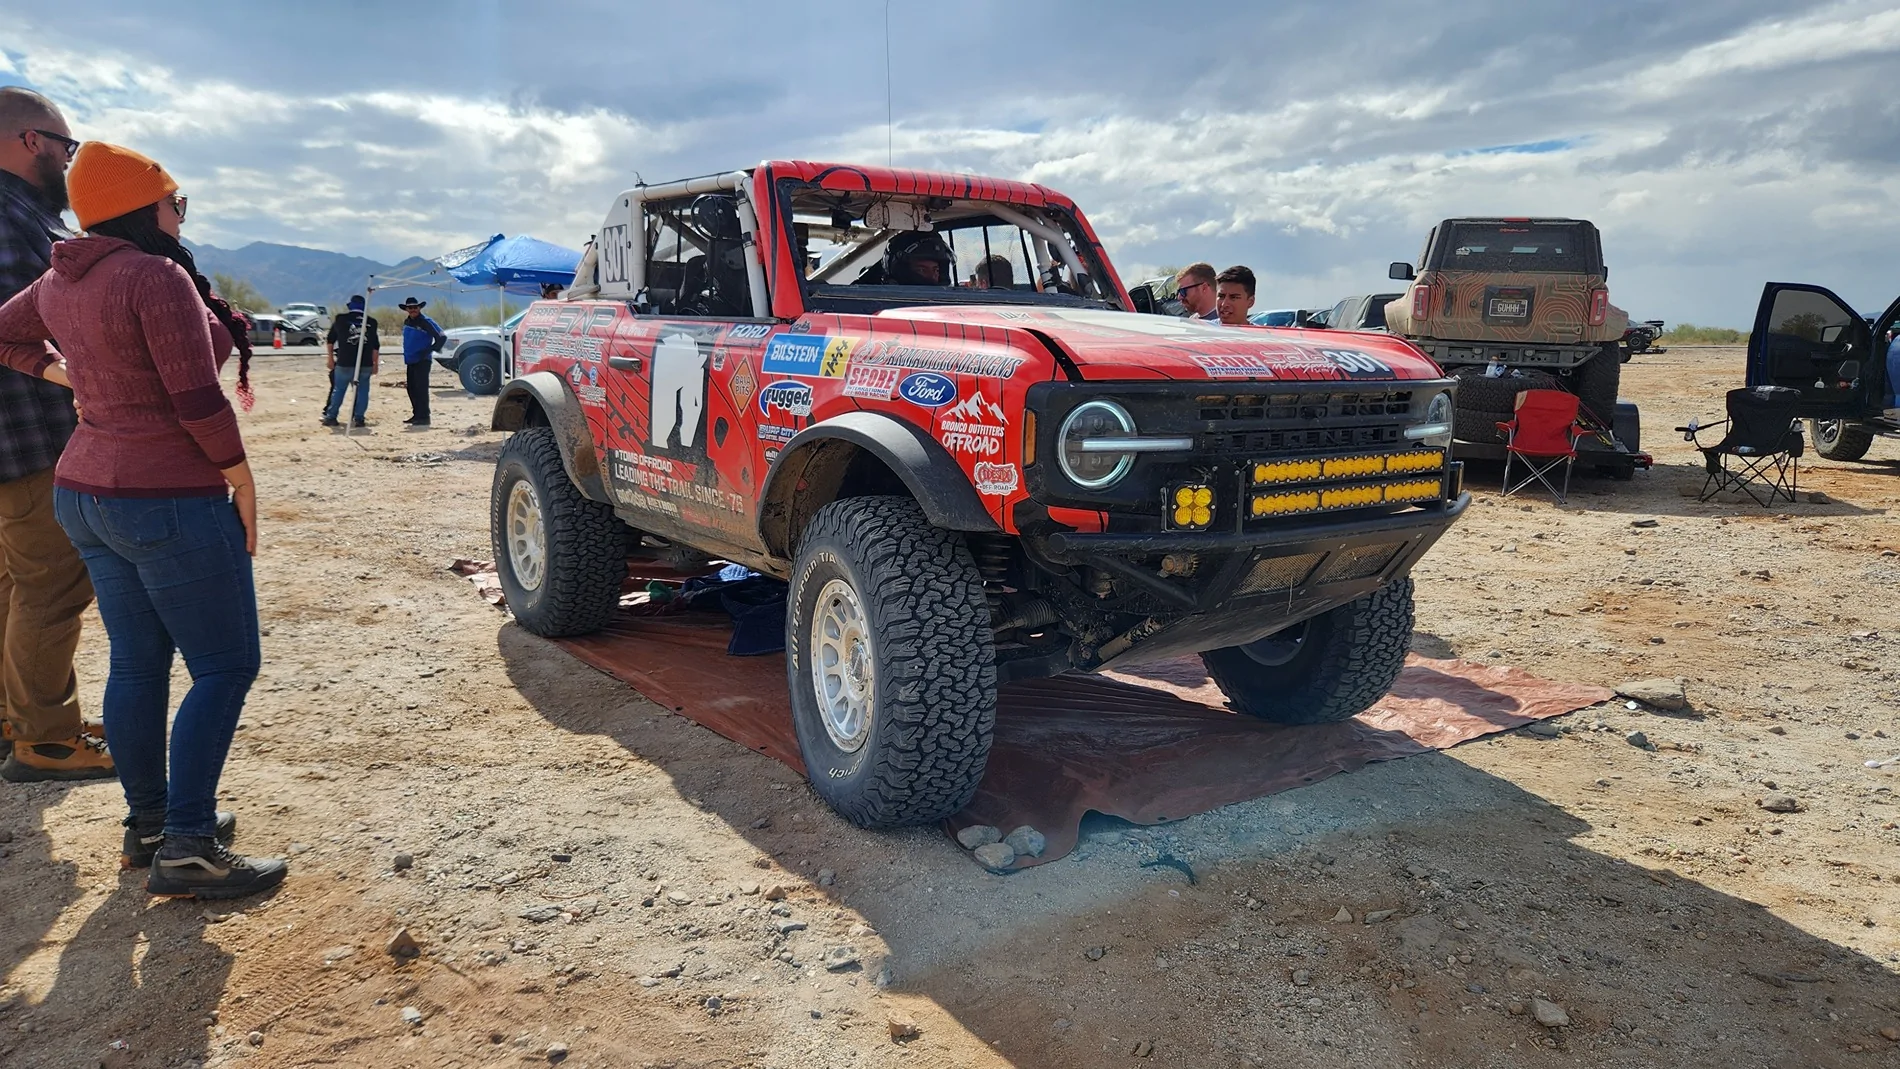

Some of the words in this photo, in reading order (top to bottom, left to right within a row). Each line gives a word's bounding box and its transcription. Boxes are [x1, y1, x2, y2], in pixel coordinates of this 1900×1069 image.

[604, 225, 628, 282] 301
[729, 324, 772, 339] FORD
[770, 344, 819, 364] BILSTEIN
[887, 346, 958, 371] ARMADILLO
[956, 352, 1025, 379] DESIGNS
[1196, 356, 1263, 367] SCORE
[1322, 350, 1391, 373] 301
[850, 367, 897, 389] SCORE
[908, 375, 945, 402] Ford
[735, 385, 750, 396] PITS
[846, 386, 889, 394] INTERNATIONAL
[941, 420, 968, 433] BRONCO
[968, 423, 1005, 437] OUTFITTERS
[942, 432, 1000, 456] OFFROAD
[638, 454, 673, 473] OFFROAD
[614, 463, 649, 487] LEADING
[649, 472, 668, 492] THE
[667, 477, 695, 500] TRAIL
[694, 484, 726, 509] SINCE
[646, 496, 678, 513] METHOD
[792, 558, 818, 671] All-Terrain
[818, 551, 837, 564] T/A
